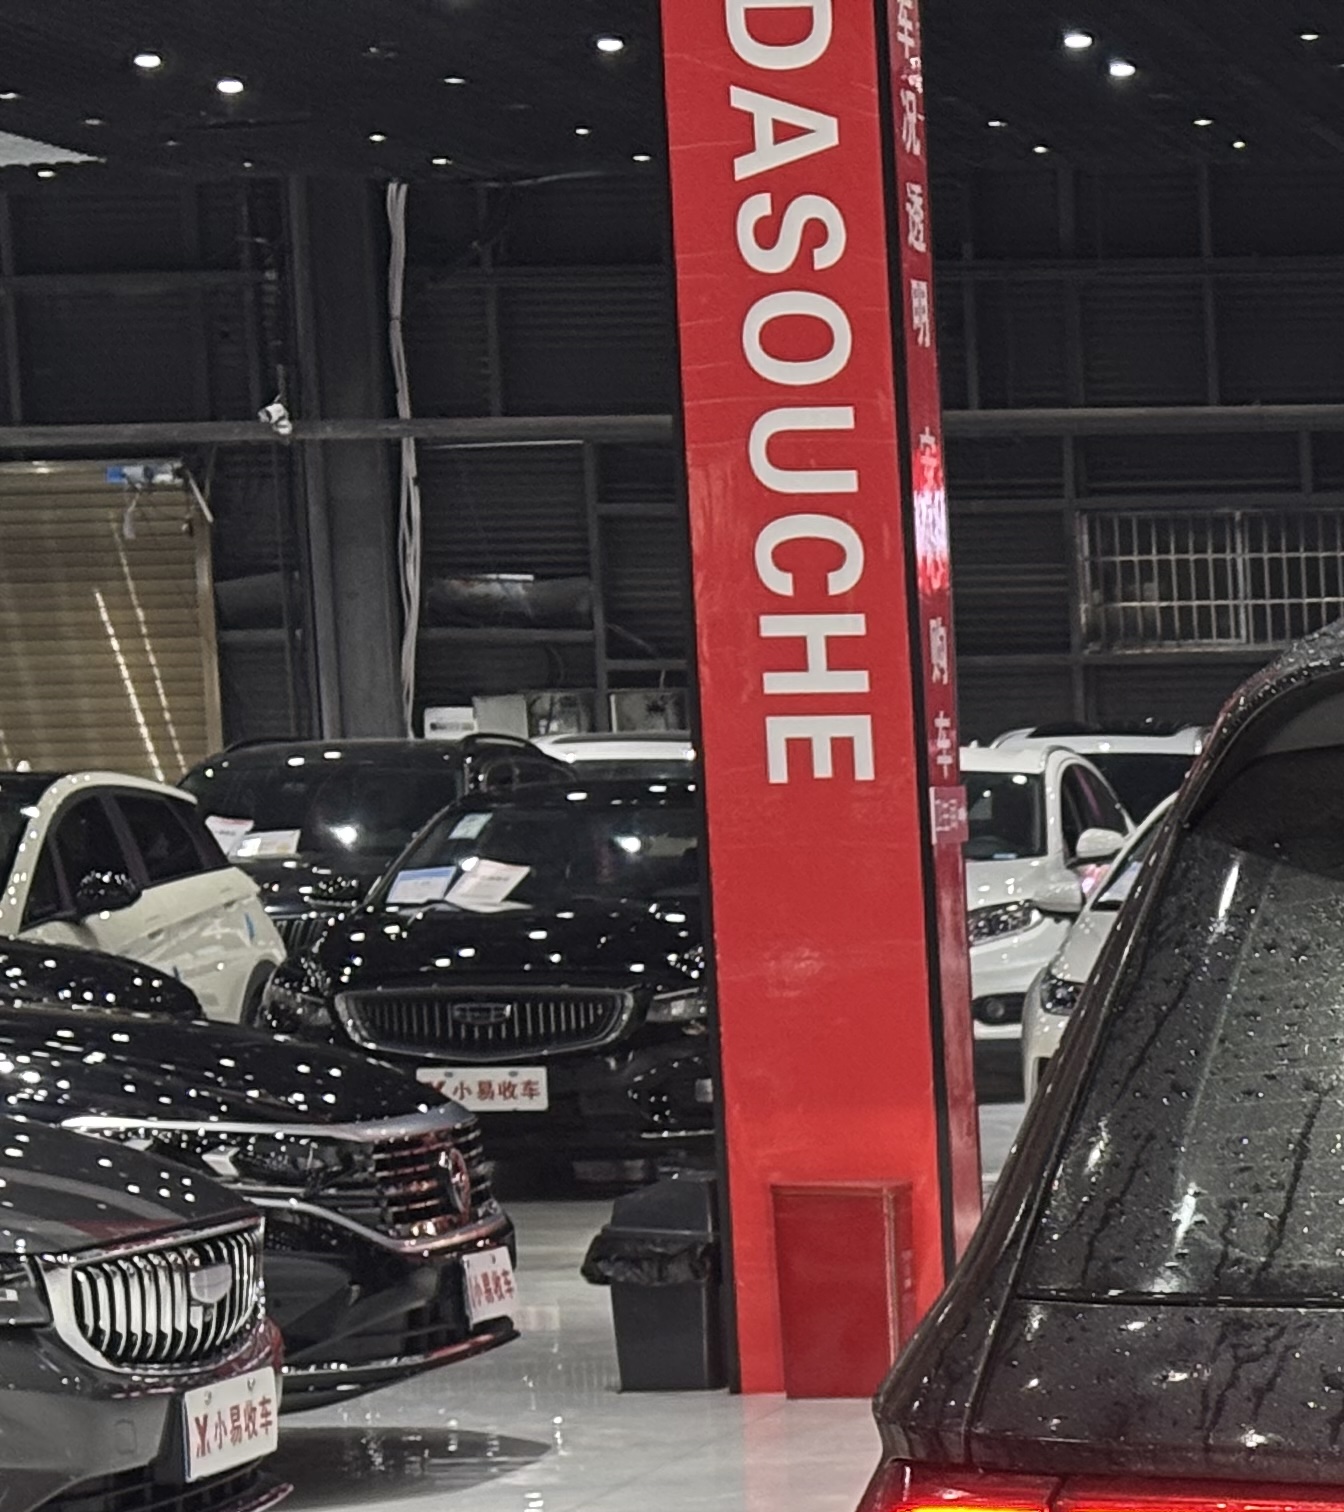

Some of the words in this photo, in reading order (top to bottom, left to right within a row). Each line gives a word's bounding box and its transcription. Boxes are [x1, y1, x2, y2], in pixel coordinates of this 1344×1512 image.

[726, 0, 875, 784] DASOUCHE
[452, 1079, 542, 1102] 小易收车
[214, 1395, 274, 1450] 小易收车
